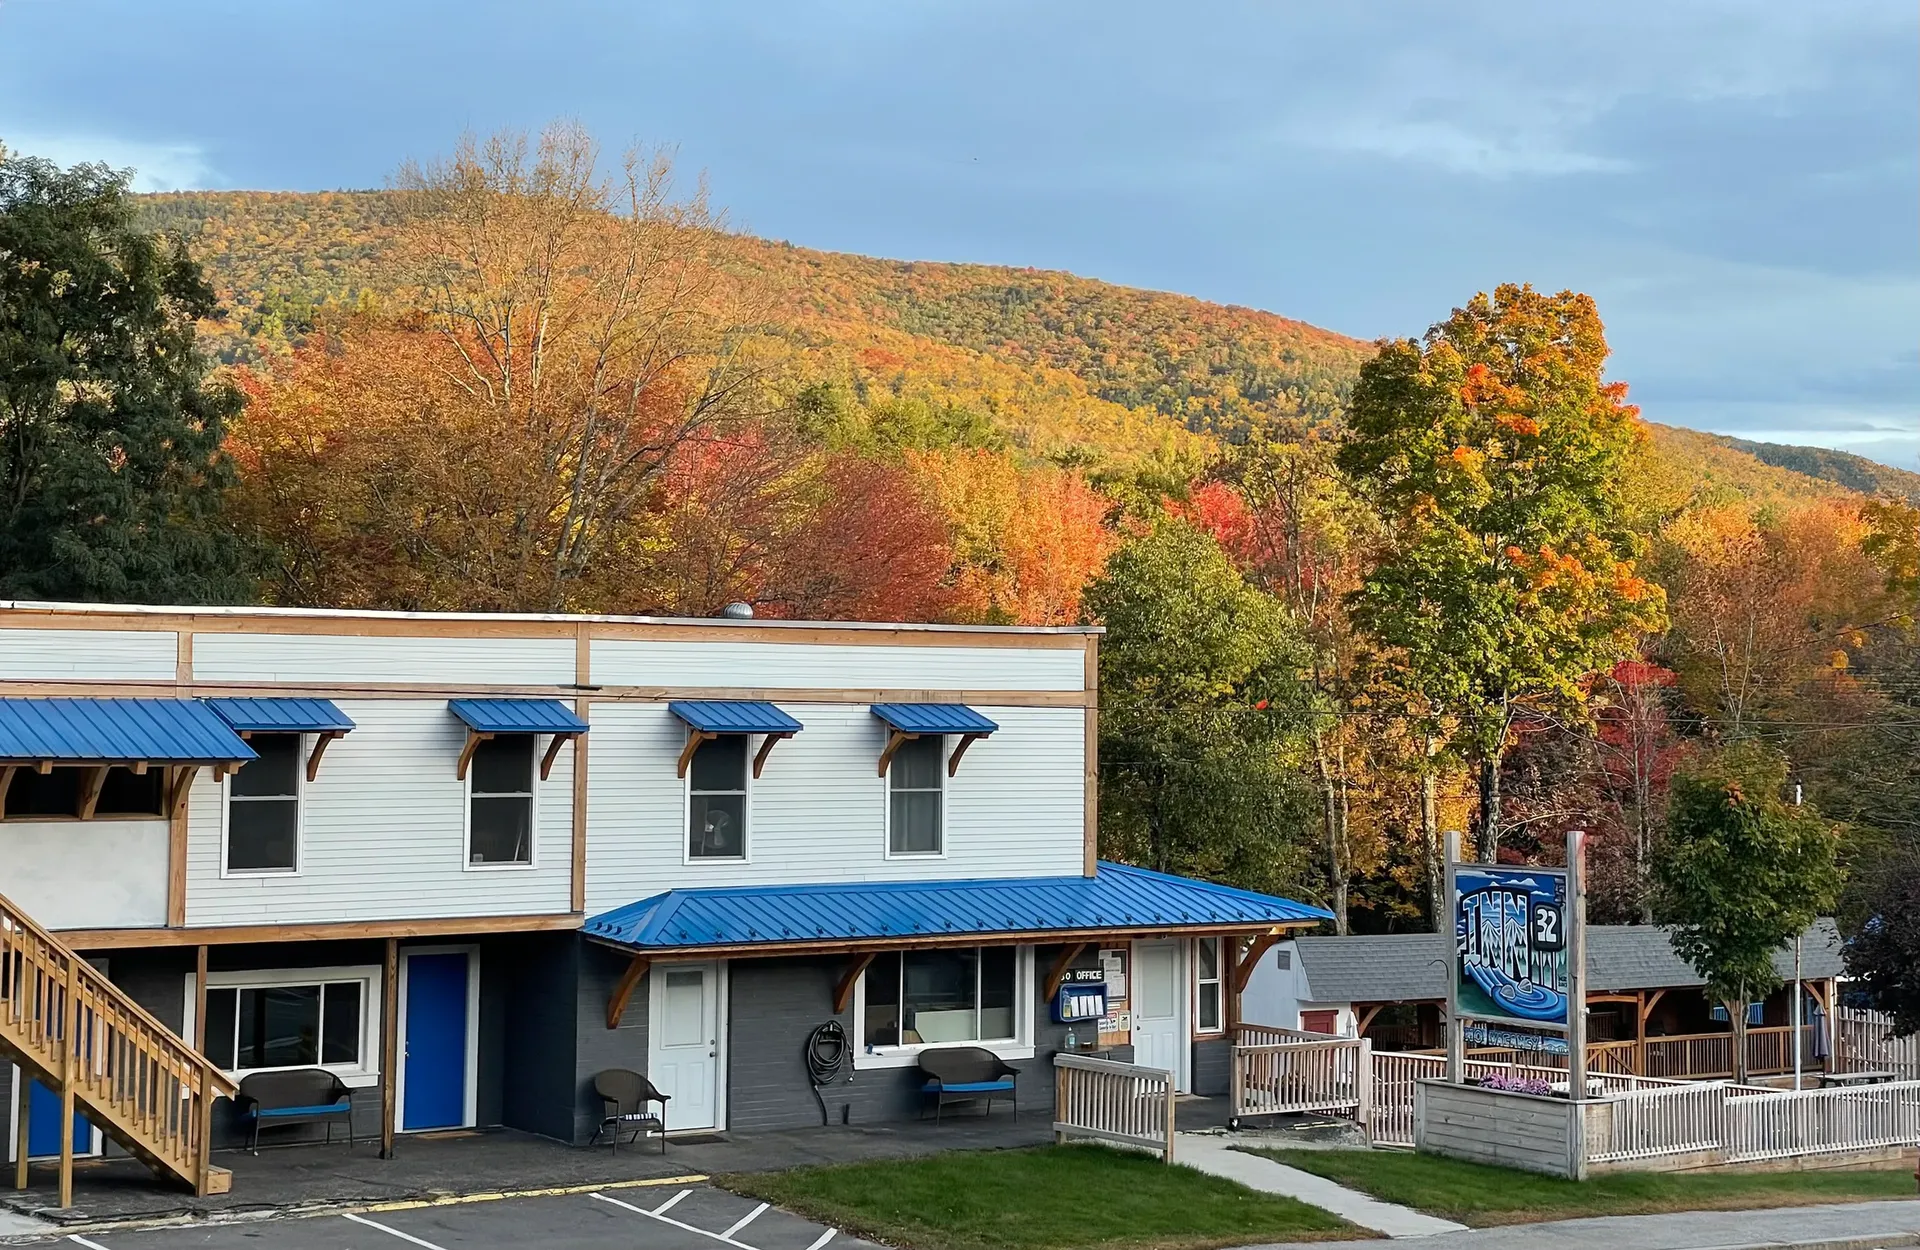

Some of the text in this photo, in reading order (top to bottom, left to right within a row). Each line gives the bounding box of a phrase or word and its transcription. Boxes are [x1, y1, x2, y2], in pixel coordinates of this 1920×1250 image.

[1462, 891, 1557, 979] INN 32
[1076, 970, 1102, 980] OFFICE
[1488, 1030, 1539, 1051] VACANCY
